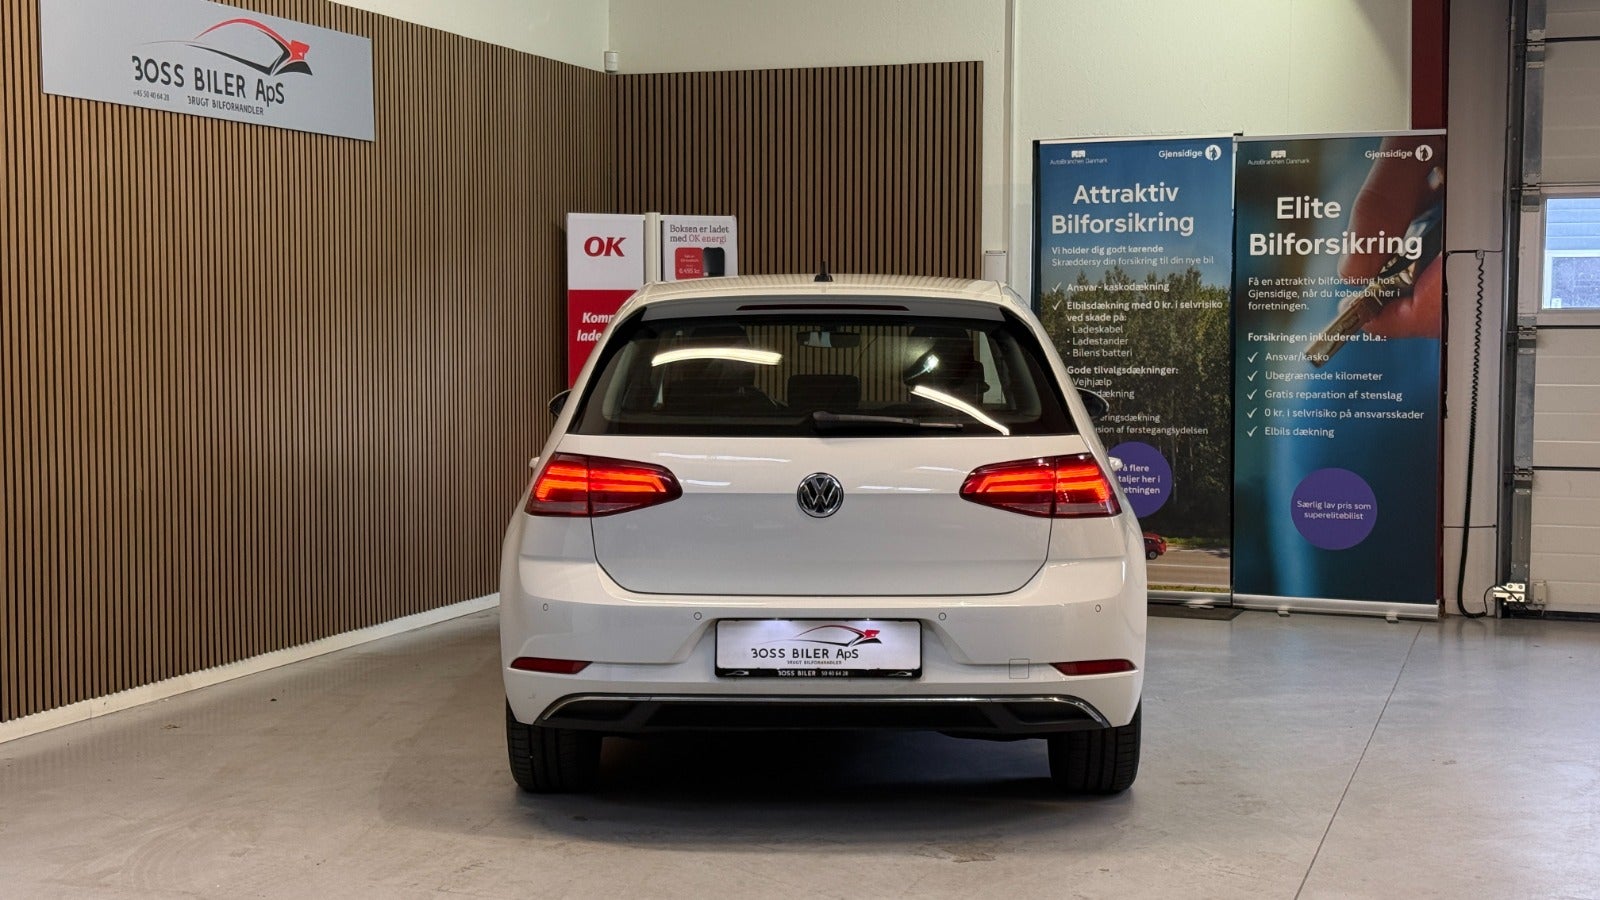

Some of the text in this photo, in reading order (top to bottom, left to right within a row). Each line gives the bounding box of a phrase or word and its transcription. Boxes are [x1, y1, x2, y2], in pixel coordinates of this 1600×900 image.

[194, 67, 246, 98] BILER
[256, 78, 285, 107] ApS
[212, 100, 264, 116] BILFORHANDLER
[1158, 149, 1203, 160] Gjensidige
[1364, 150, 1412, 161] Gjensidige
[1072, 182, 1179, 205] Attraktiv
[1276, 195, 1342, 220] Elite
[670, 224, 698, 234] Boksen
[709, 224, 730, 234] ladet
[1052, 212, 1194, 237] Bilforsikring
[670, 234, 727, 244] med OK energi
[584, 236, 627, 257] OK
[1052, 245, 1164, 256] Vi holder dig godt kørende
[1250, 230, 1422, 260] Bilforsikring
[1052, 256, 1214, 268] Skræddersy din forsikring til din nye bil
[1248, 276, 1395, 287] Få en attraktiv bilforsikring hos
[1067, 282, 1170, 293] Ansvar- kaskodækning
[1248, 289, 1300, 300] Gjensidige,
[1302, 288, 1318, 298] når
[1320, 289, 1333, 298] du
[1364, 288, 1376, 298] bil
[1378, 288, 1394, 298] her
[1066, 301, 1130, 312] Elbilsdækning
[1132, 301, 1152, 310] med
[1154, 301, 1160, 310] 0
[1162, 301, 1174, 310] kr.
[1180, 300, 1223, 310] selvrisiko
[1248, 302, 1310, 312] forretningen.
[1066, 312, 1127, 324] ved skade på:
[1072, 325, 1124, 334] Ladeskabel
[1072, 337, 1128, 346] Ladestander
[1248, 332, 1308, 344] Forsikringen
[1310, 332, 1360, 342] inkluderer
[1072, 349, 1133, 358] Bilens batteri
[1265, 352, 1330, 363] Ansvar/kasko
[1066, 366, 1179, 376] Gode tilvalgsdækninger:
[1265, 371, 1382, 382] Ubegrænsede kilometer
[1072, 377, 1112, 388] Vejhjælp
[1097, 390, 1135, 400] dækning
[1264, 390, 1403, 402] Gratis reparation af stenslag
[1100, 413, 1160, 424] ringsdækning
[1264, 408, 1271, 418] 0
[1273, 408, 1284, 418] kr.
[1292, 408, 1338, 418] selvrisiko
[1340, 408, 1352, 420] på
[1354, 410, 1424, 420] ansvarsskader
[1096, 425, 1208, 436] sion af førstegangsydelsen
[1264, 426, 1334, 438] Elbils dækning
[1130, 464, 1150, 472] flere
[1118, 475, 1140, 484] taljer
[1142, 475, 1155, 483] her
[1121, 486, 1160, 495] etningen
[1296, 500, 1372, 512] Særlig lav pris som
[1304, 510, 1364, 520] superelitebilist
[792, 648, 829, 659] BILER
[836, 648, 859, 660] ApS
